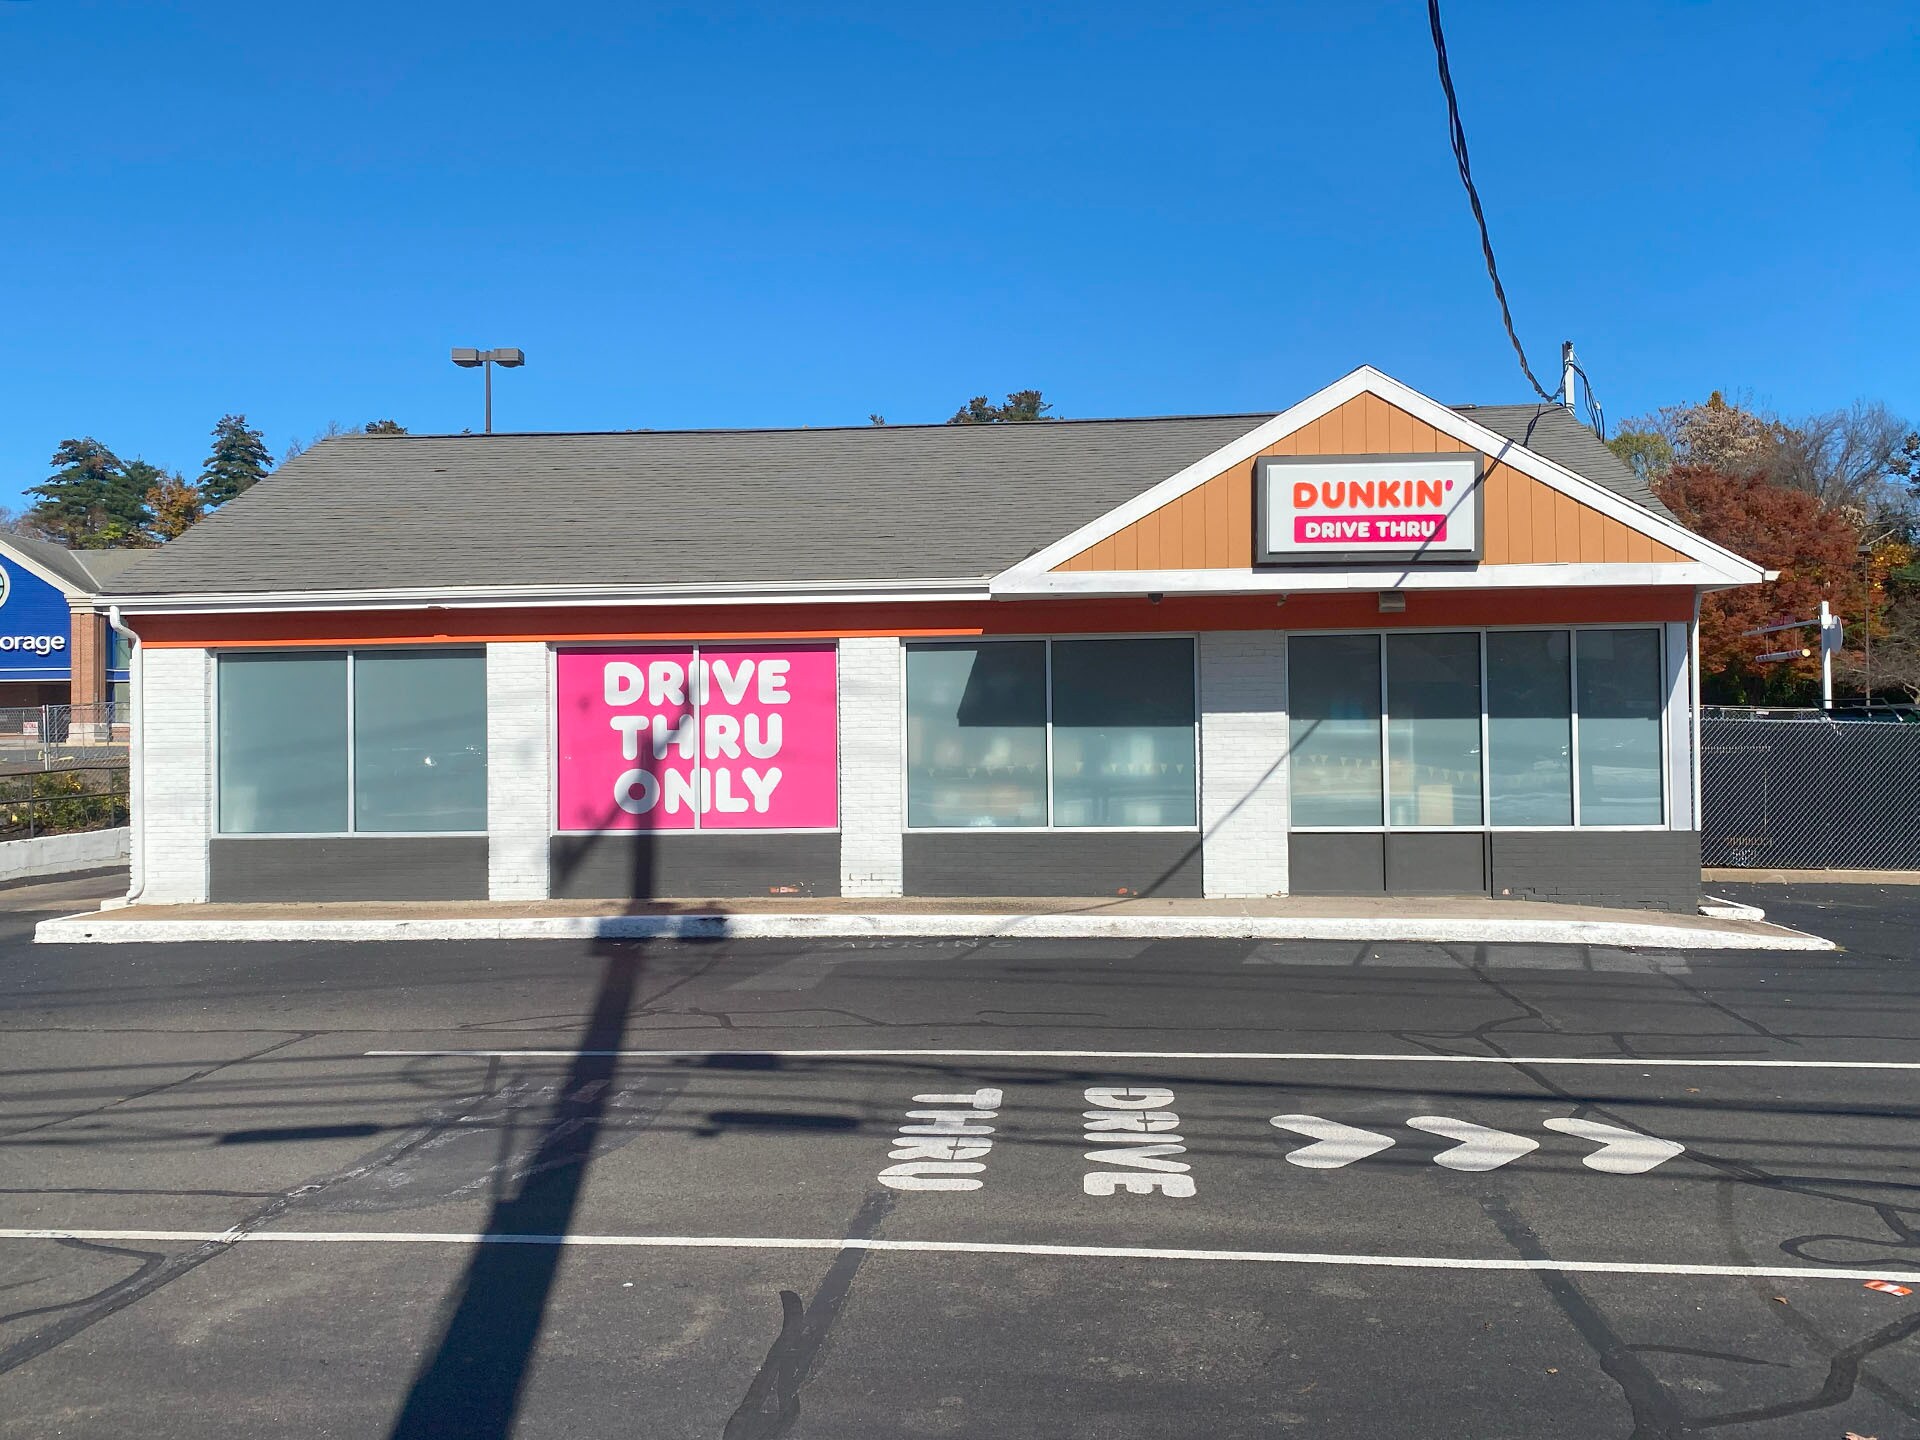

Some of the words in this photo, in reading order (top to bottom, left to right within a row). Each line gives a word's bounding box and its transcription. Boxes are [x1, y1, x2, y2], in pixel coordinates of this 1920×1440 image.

[1293, 479, 1453, 509] DUNKIN'
[1305, 521, 1371, 539] DRIVE
[1376, 520, 1436, 538] THRU
[604, 659, 791, 706] DRIVE
[610, 713, 783, 761] THRU
[613, 767, 783, 814] ONLY
[877, 1087, 1003, 1191] THRU
[1082, 1087, 1197, 1198] DRIVE
